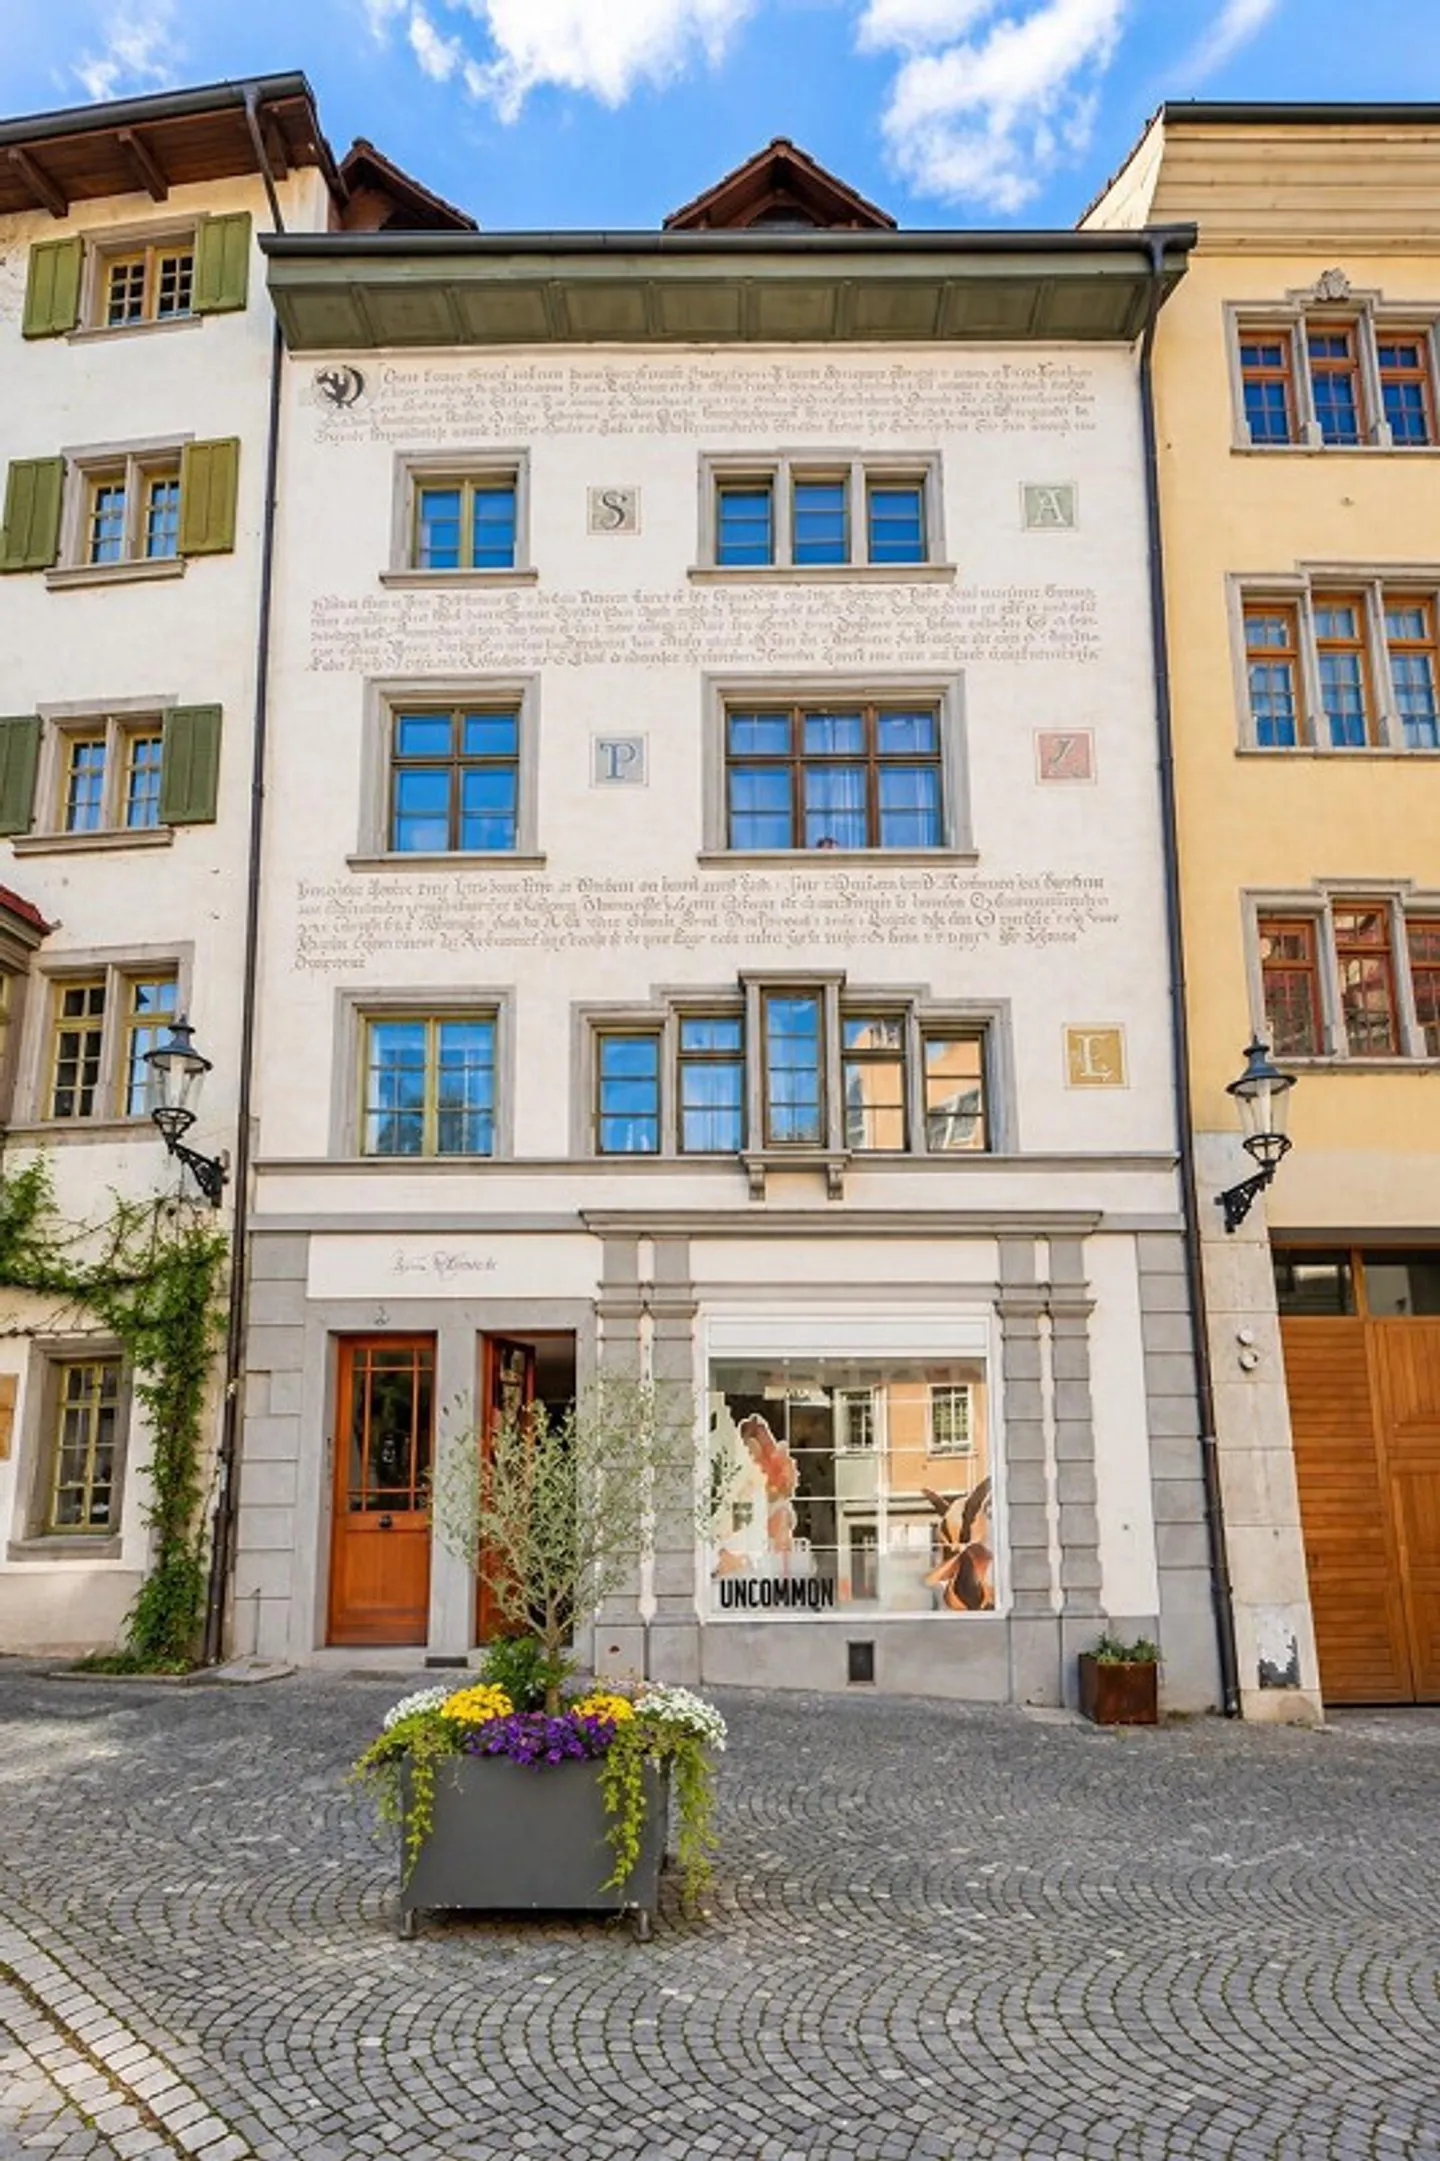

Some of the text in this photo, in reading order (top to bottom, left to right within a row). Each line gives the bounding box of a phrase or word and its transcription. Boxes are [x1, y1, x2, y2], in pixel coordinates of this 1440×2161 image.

[600, 490, 628, 531] S
[1034, 489, 1069, 527] A
[599, 742, 637, 780] P
